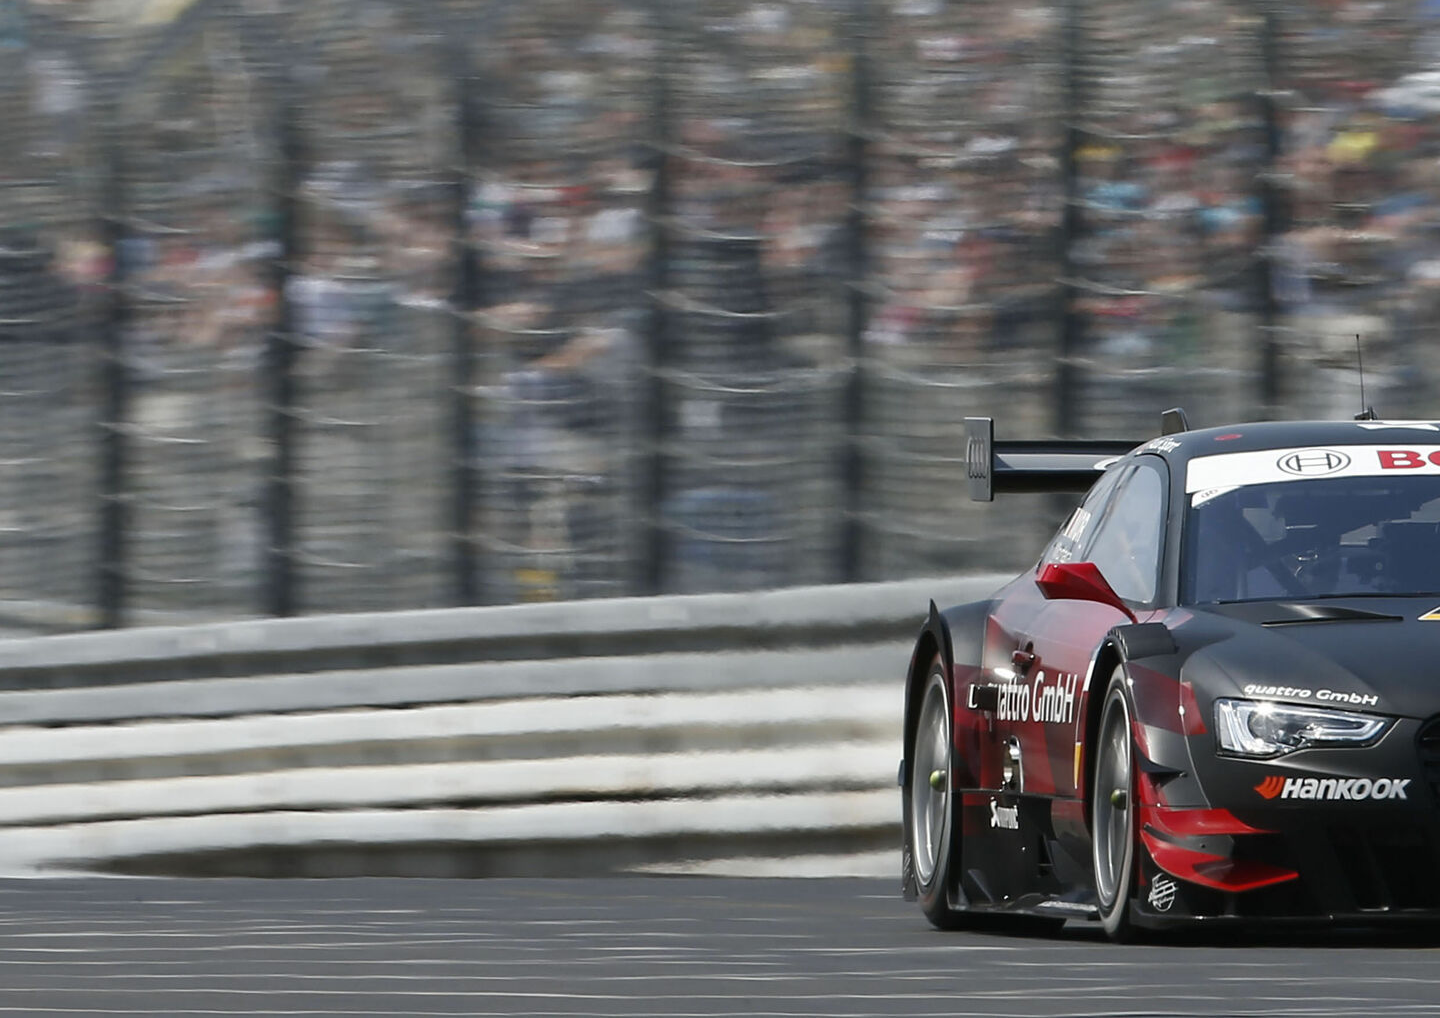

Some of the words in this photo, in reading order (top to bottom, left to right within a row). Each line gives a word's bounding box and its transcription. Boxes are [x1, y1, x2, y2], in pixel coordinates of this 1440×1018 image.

[1032, 670, 1077, 723] GmbH
[1244, 684, 1312, 698] quattro
[1316, 689, 1378, 706] GmbH
